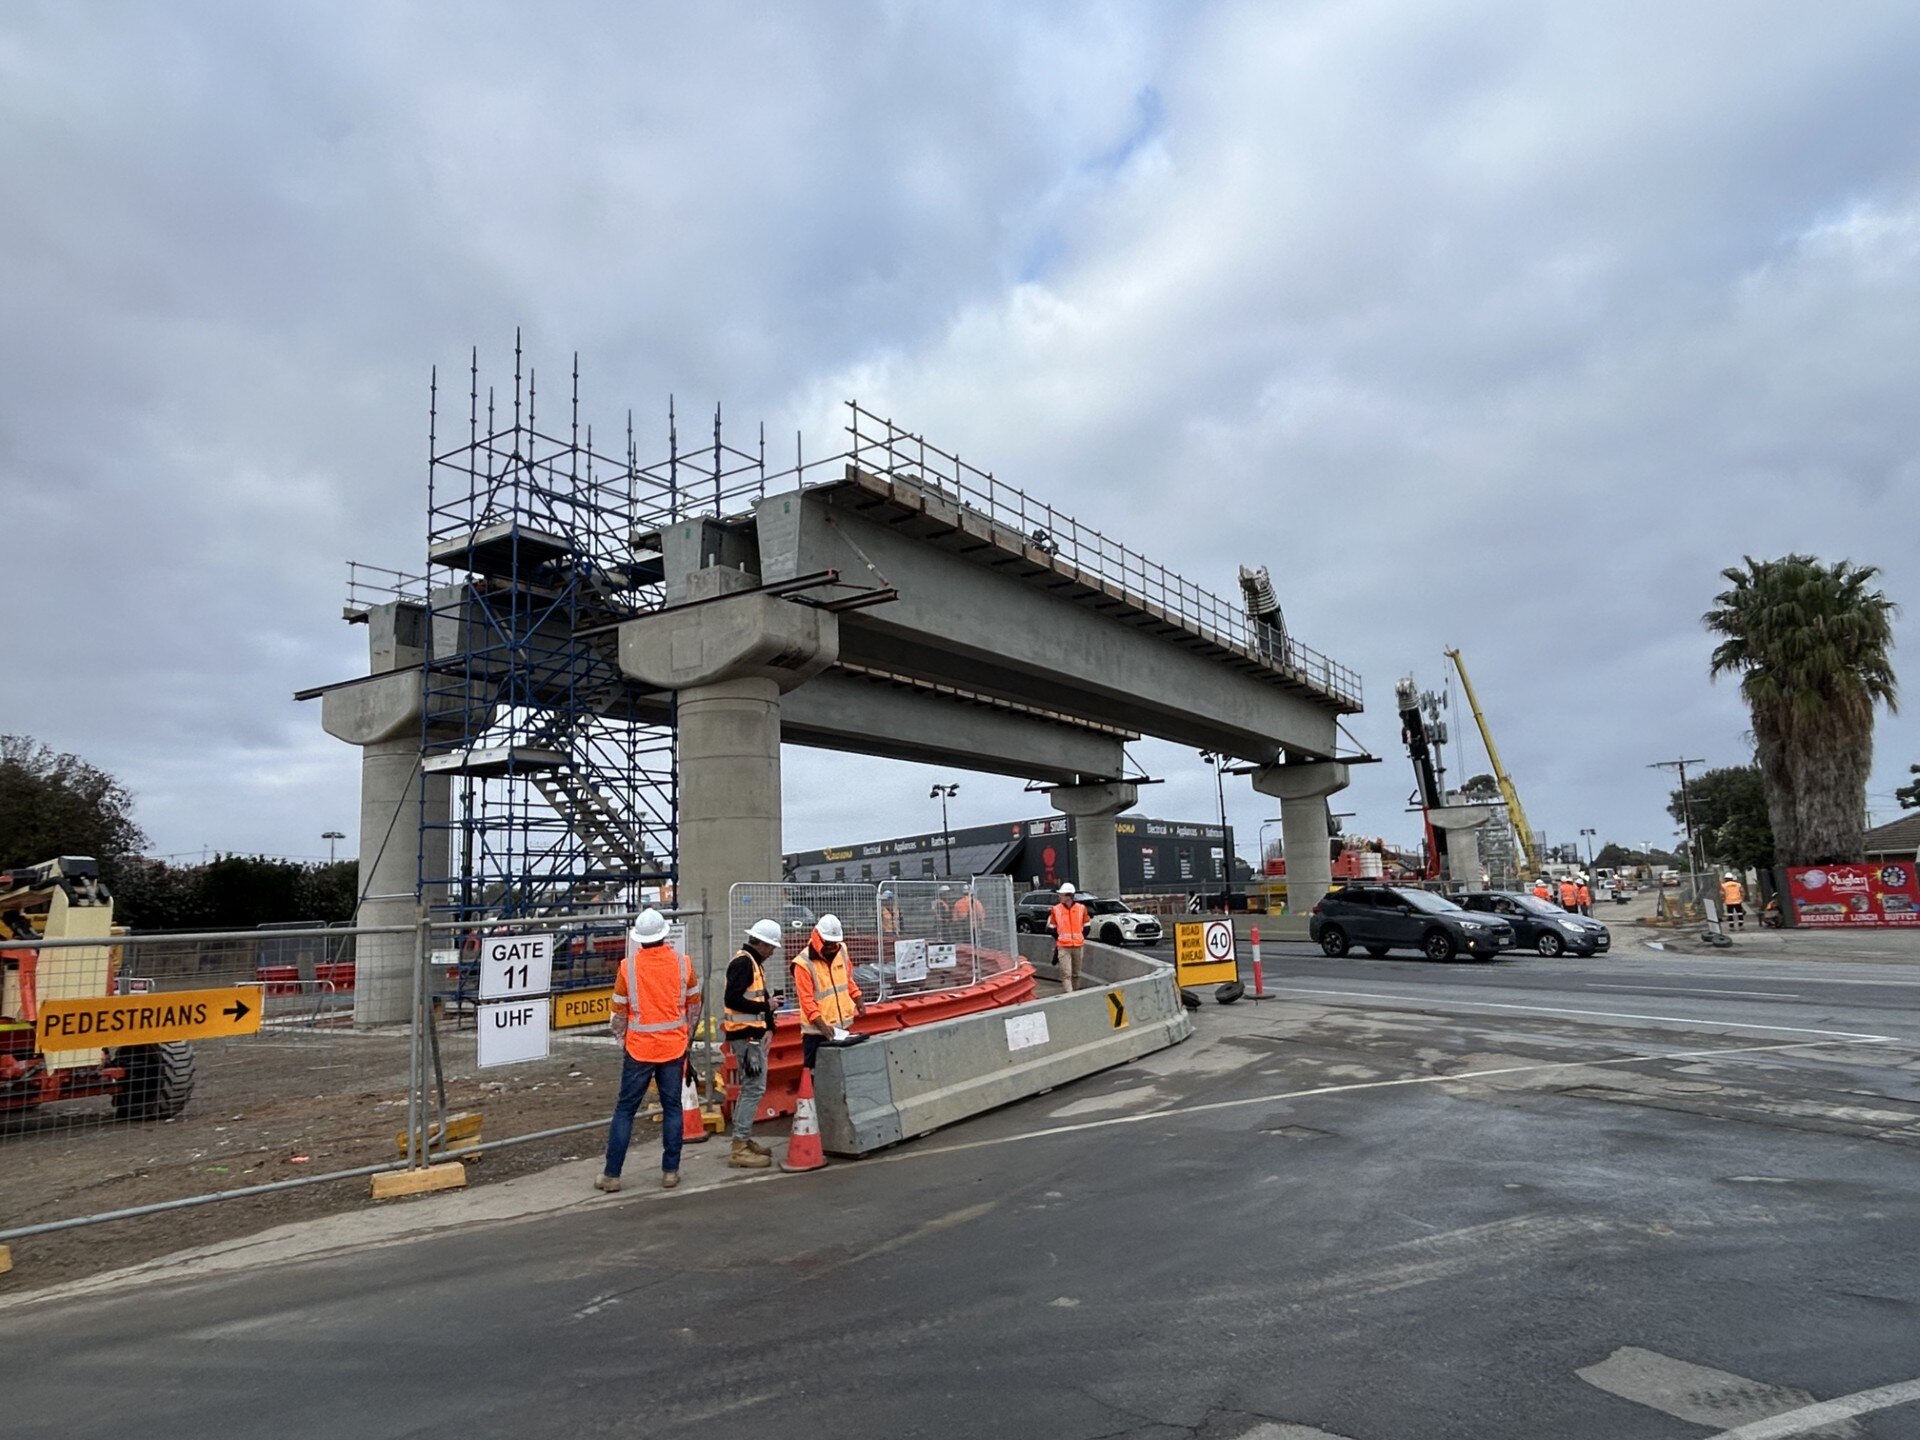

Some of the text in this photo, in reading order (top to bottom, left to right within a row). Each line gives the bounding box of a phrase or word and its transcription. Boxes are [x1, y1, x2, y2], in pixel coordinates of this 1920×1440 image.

[1850, 913, 1878, 921] LUNCH
[1884, 912, 1918, 920] BUFFET
[1181, 925, 1200, 936] ROAD
[1181, 938, 1201, 948] WORK
[1210, 932, 1228, 949] 40
[492, 942, 543, 961] GATE
[1180, 950, 1204, 961] AHEAD
[504, 965, 528, 989] 11
[565, 997, 610, 1017] PEDEST
[44, 1003, 207, 1037] PEDESTRIANS
[495, 1008, 533, 1028] UHF
